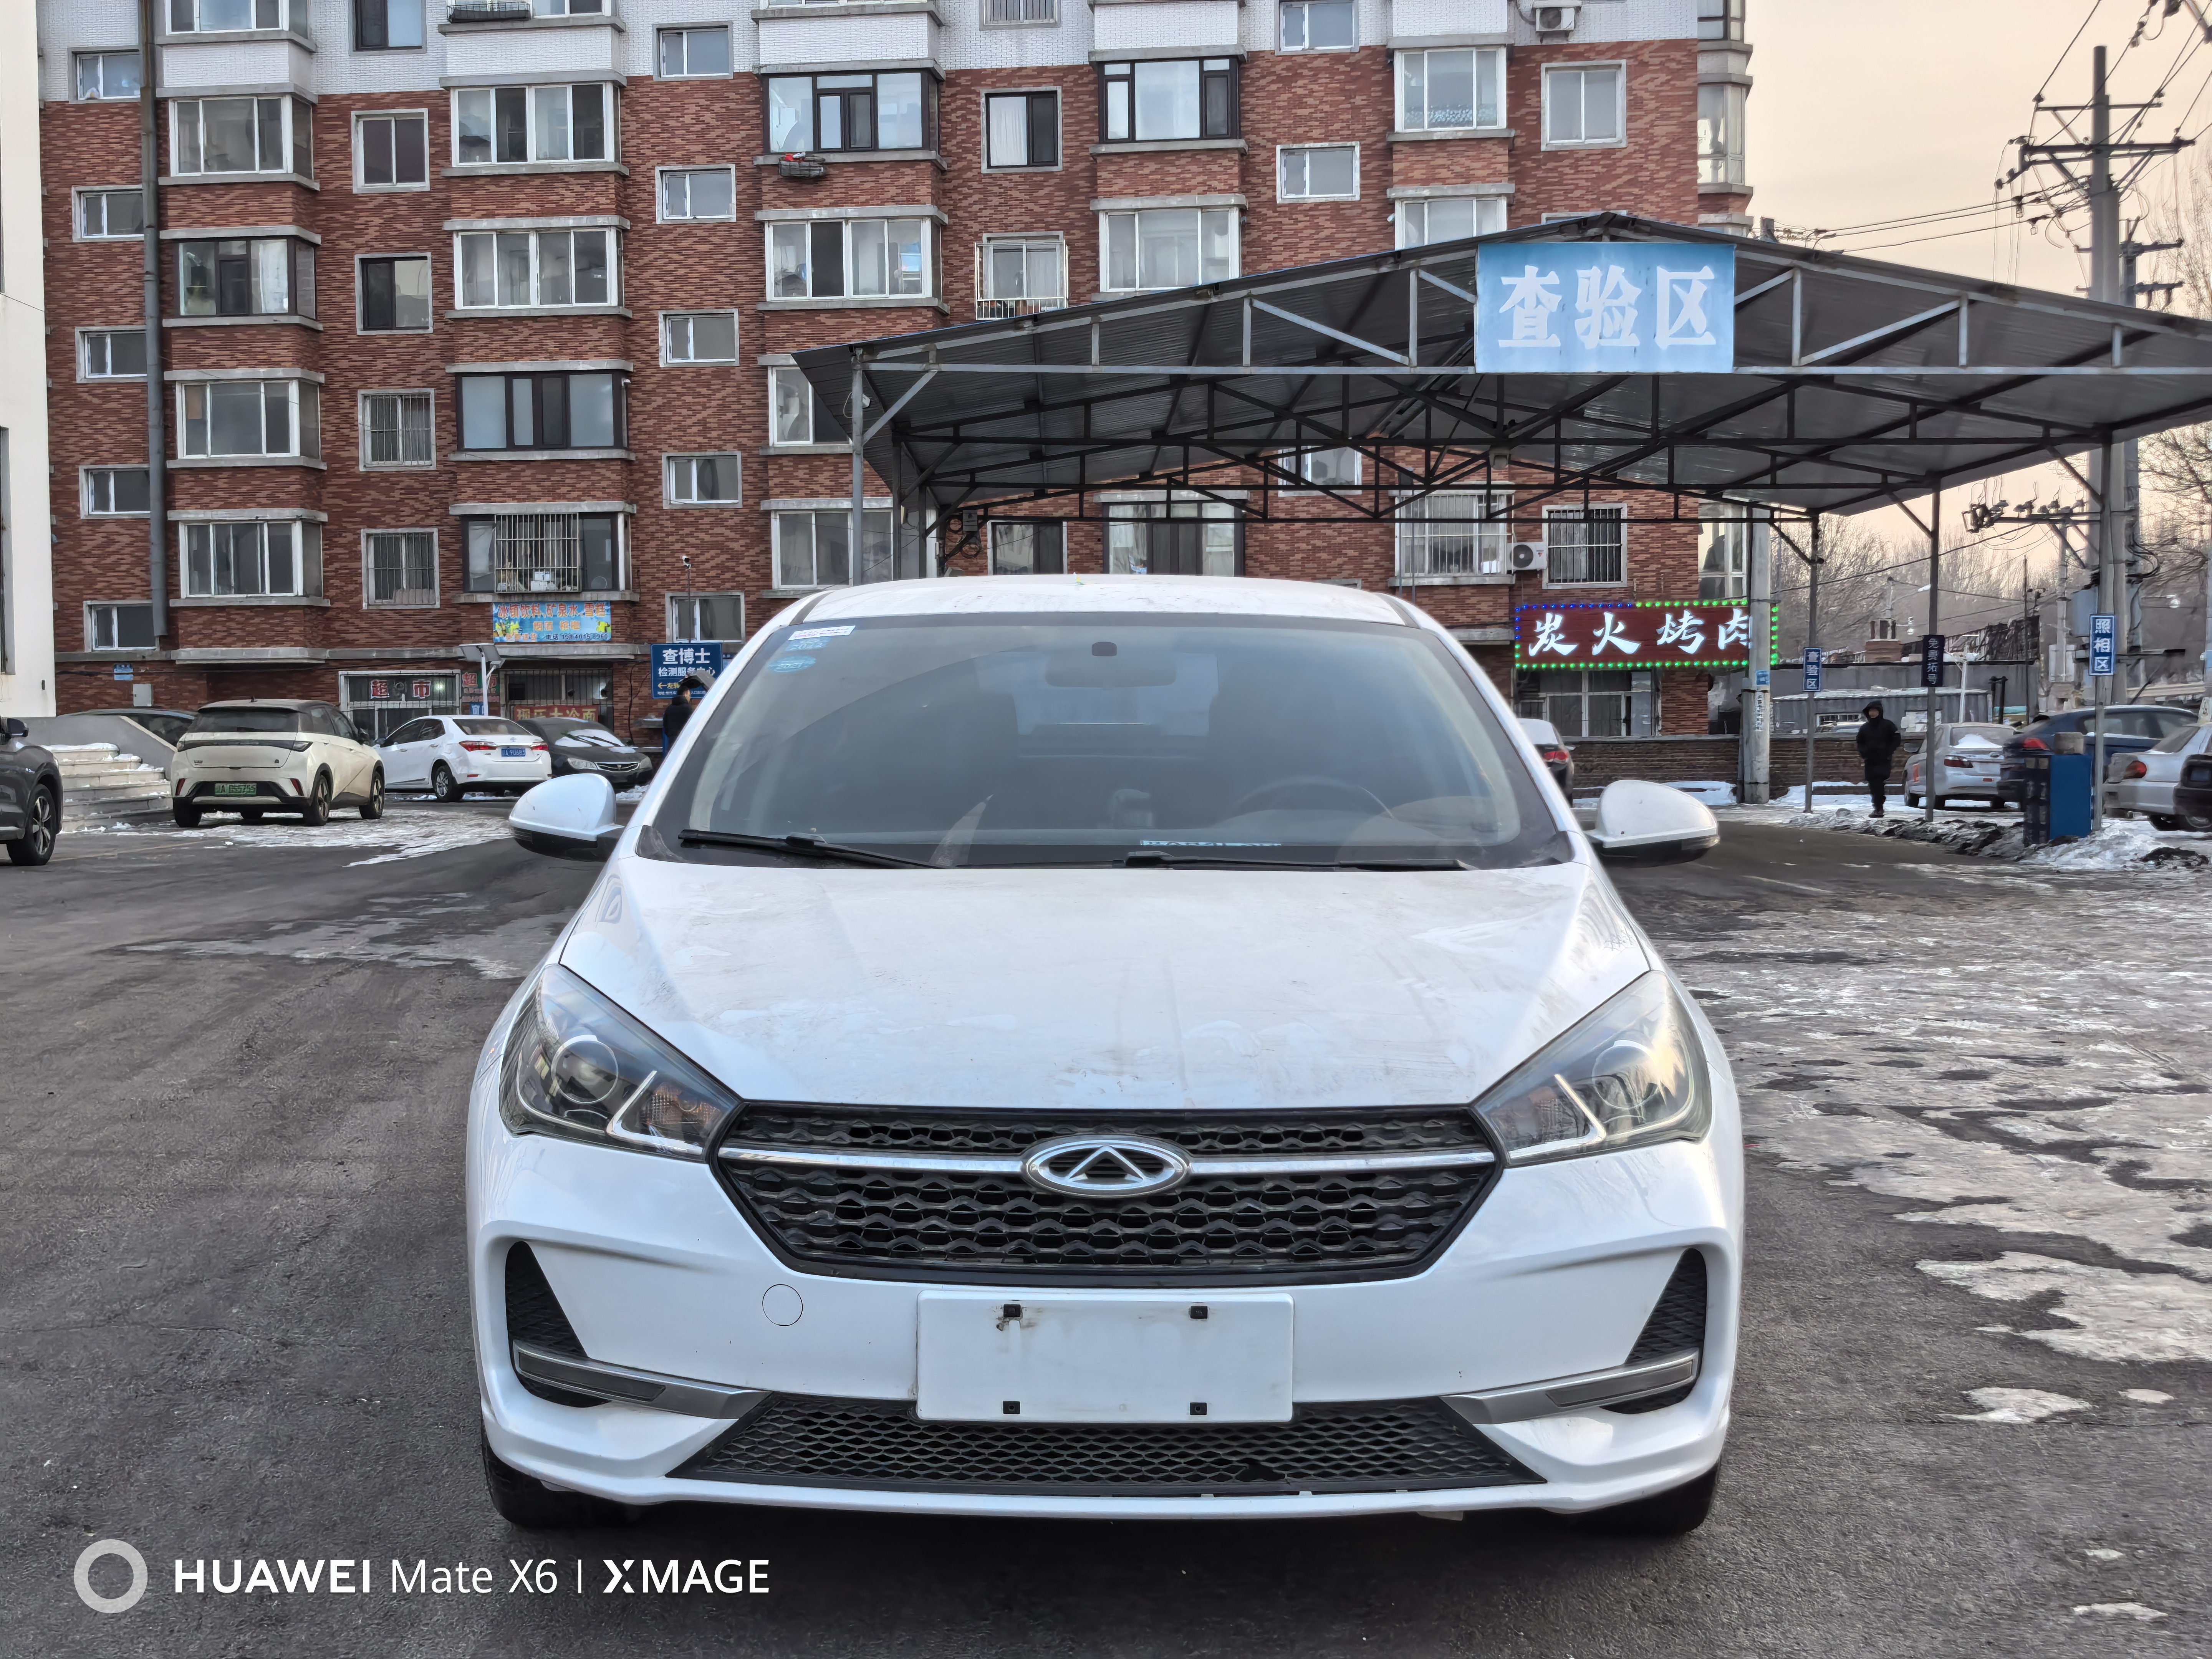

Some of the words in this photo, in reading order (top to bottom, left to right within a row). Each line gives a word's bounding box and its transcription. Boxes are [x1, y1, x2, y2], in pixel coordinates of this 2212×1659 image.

[1498, 265, 1717, 350] 查验区
[1528, 608, 1752, 656] 炭火烤肉
[2093, 619, 2112, 671] 照相区
[662, 648, 710, 664] 查博士
[1805, 651, 1819, 689] 查验区
[1926, 638, 1939, 684] 免费拓号
